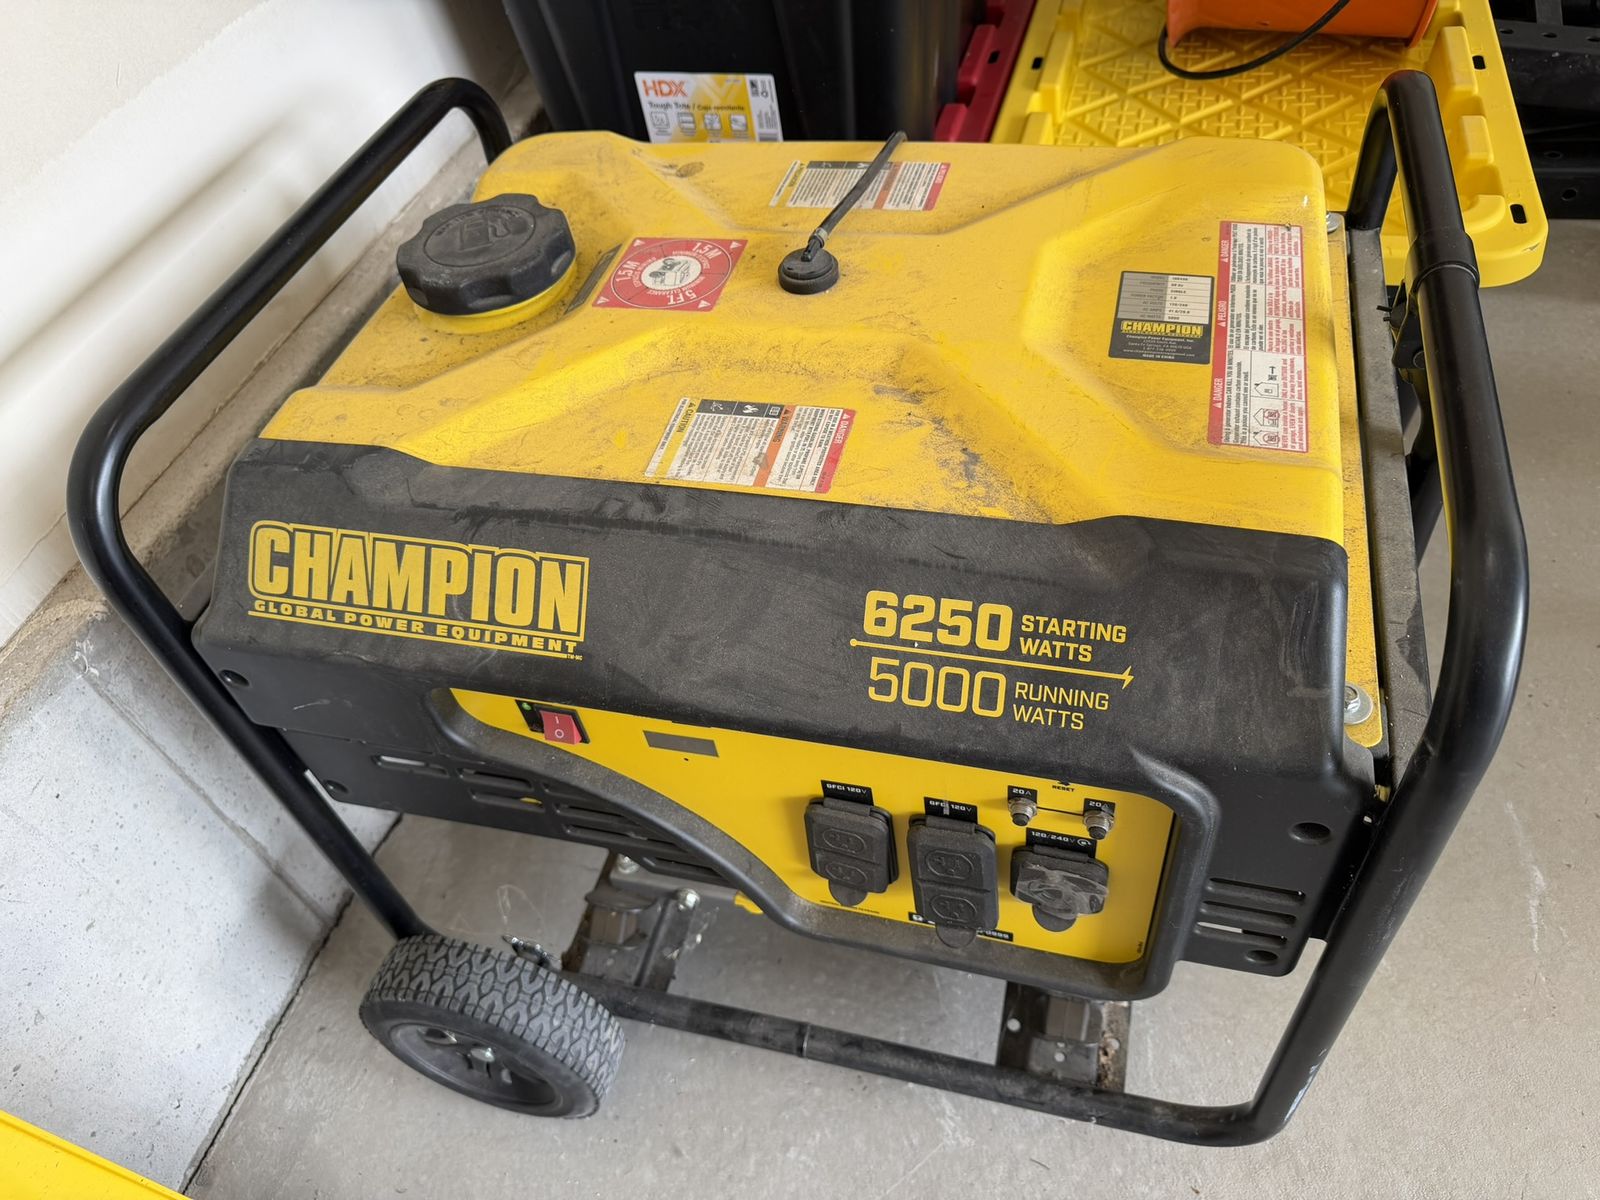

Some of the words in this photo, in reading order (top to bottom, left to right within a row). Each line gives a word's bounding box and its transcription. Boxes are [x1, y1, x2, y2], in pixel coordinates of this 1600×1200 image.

[642, 79, 688, 98] HDX
[1122, 321, 1202, 335] CHAMPION
[1213, 377, 1222, 400] DANGER
[675, 409, 694, 432] CAUTION
[833, 420, 849, 443] DANGER
[253, 526, 582, 633] CHAMPION
[254, 600, 336, 623] GLOBAL
[345, 609, 425, 634] POWER
[436, 624, 577, 654] EQUIPMENT
[863, 590, 1013, 652] 6250
[1021, 614, 1127, 643] STARTING
[1019, 637, 1093, 663] WATTS
[868, 656, 1007, 718] 5000
[1014, 681, 1109, 711] RUNNING
[1013, 703, 1084, 730] WATTS
[826, 783, 845, 791] GFCI
